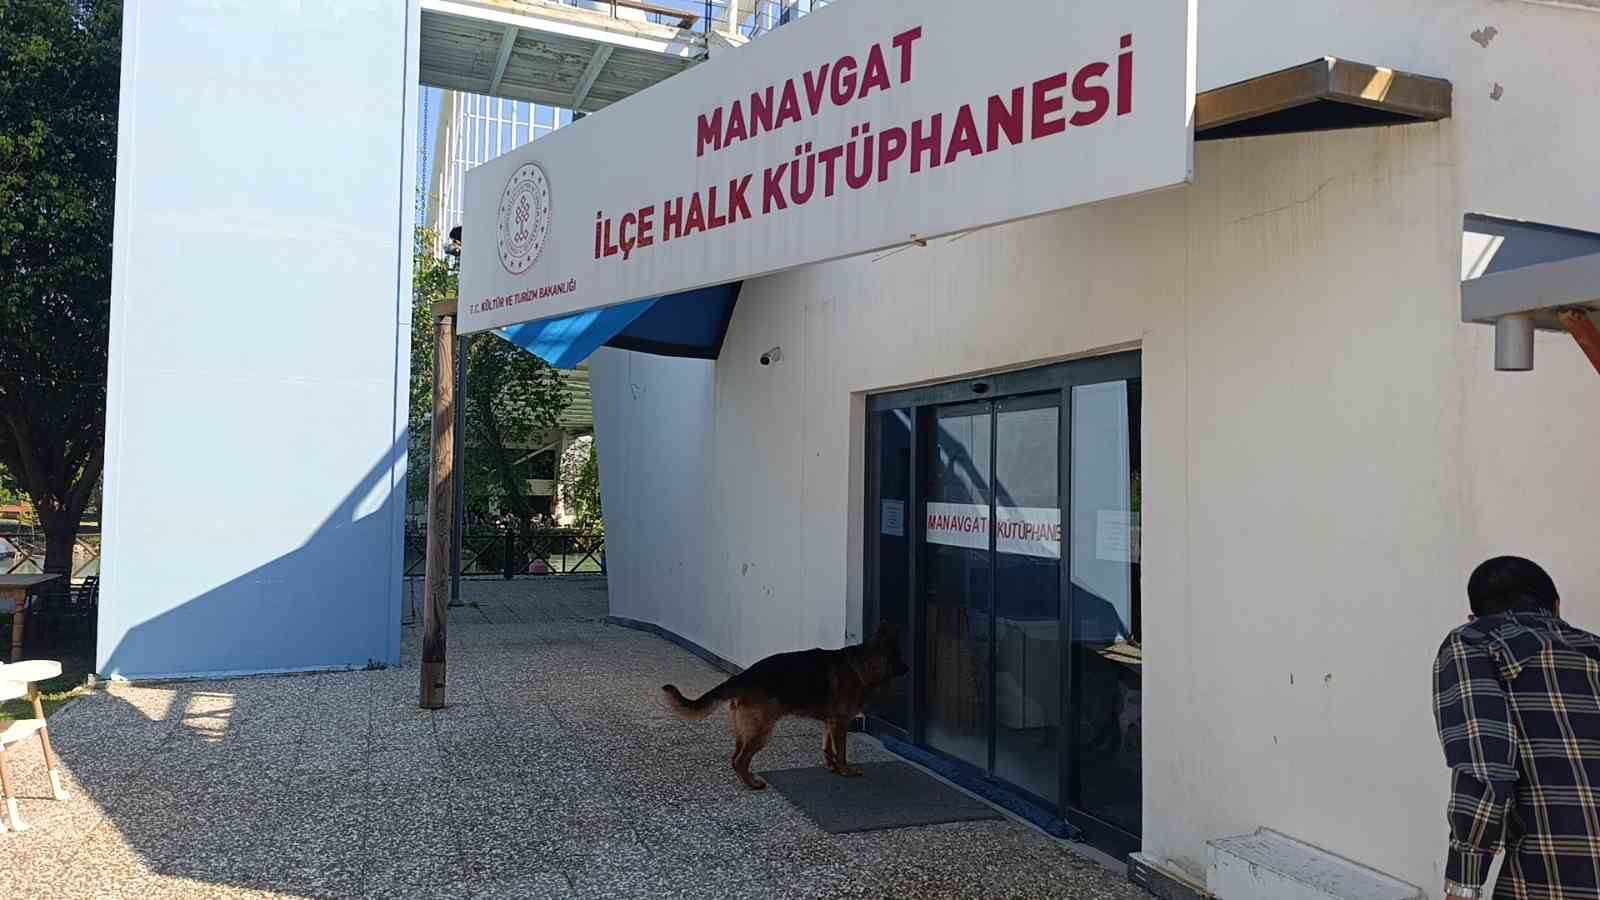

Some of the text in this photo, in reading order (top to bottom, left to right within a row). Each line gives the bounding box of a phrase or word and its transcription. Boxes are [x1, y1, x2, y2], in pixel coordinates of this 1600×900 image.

[696, 26, 922, 157] MANAVGAT
[595, 205, 655, 261] İLÇE
[663, 174, 753, 242] HALK
[762, 33, 1134, 214] KÜTÜPHANESİ
[469, 277, 577, 315] T.C. KÜLTÜR VE TURİZM BAKANLIĞI
[928, 515, 987, 533] MANAVGAT
